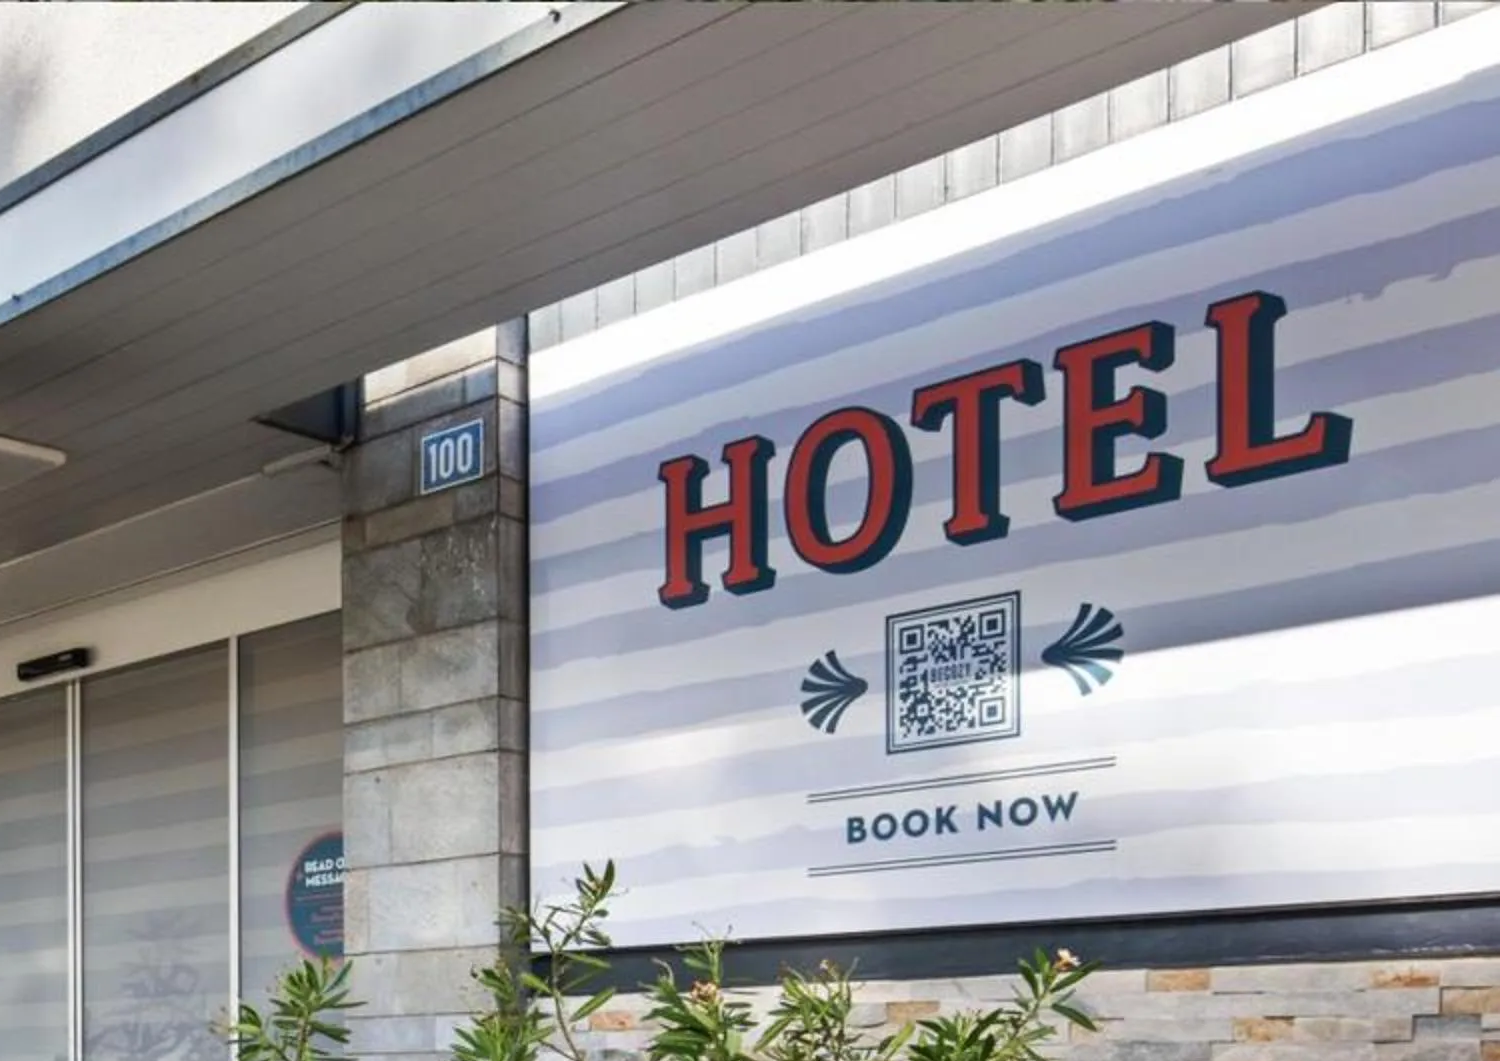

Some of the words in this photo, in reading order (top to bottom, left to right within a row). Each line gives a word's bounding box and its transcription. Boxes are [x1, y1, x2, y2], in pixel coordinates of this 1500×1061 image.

[429, 432, 473, 483] 100
[657, 290, 1353, 610] HOTEL
[846, 806, 960, 845] BOOK
[977, 791, 1079, 831] NOW
[304, 858, 334, 874] READ
